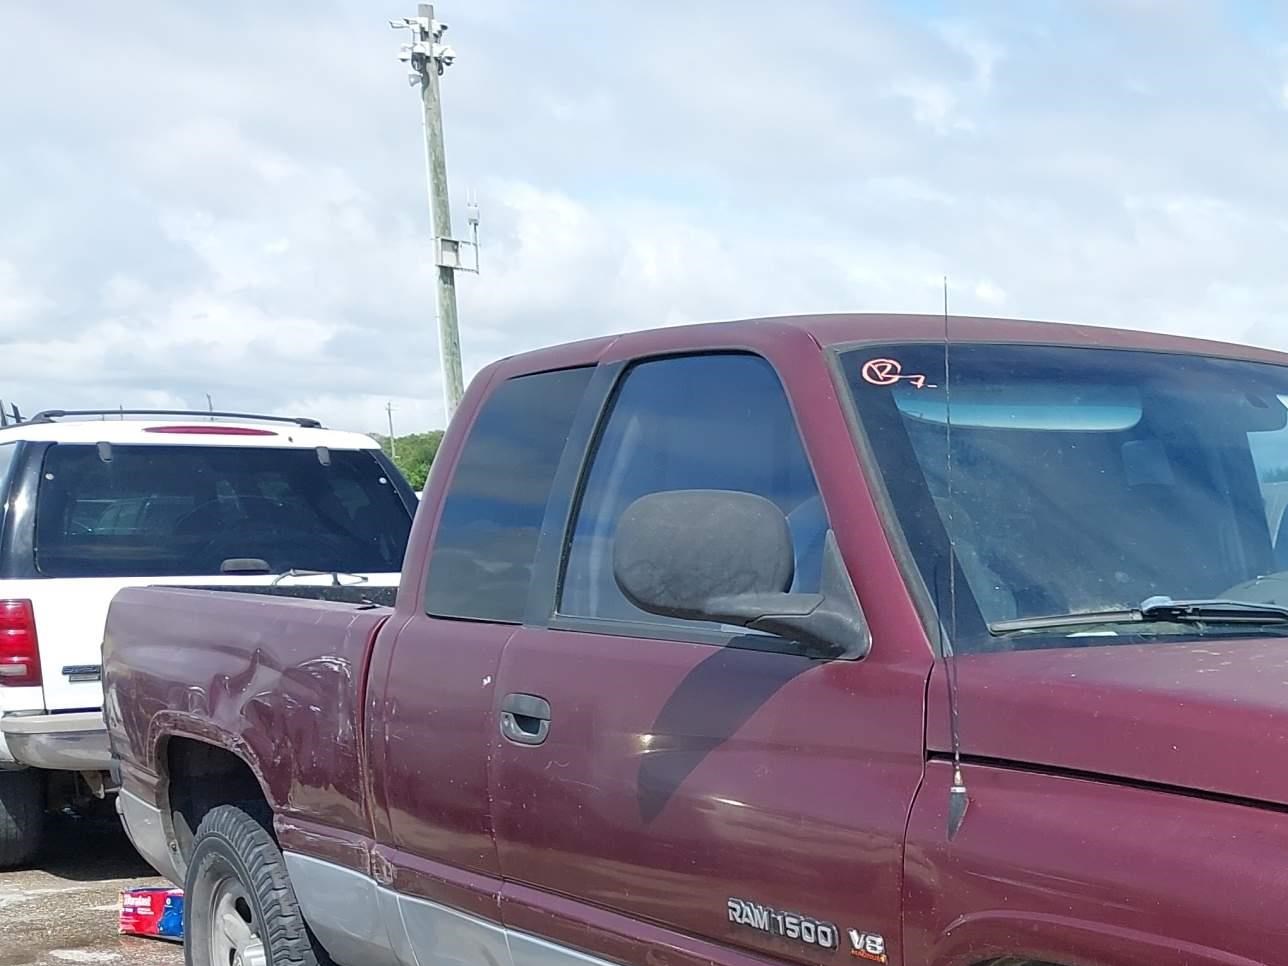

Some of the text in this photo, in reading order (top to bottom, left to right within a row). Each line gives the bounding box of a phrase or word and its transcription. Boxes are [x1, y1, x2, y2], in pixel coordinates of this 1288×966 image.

[728, 898, 885, 954] RAM 1500 V8
